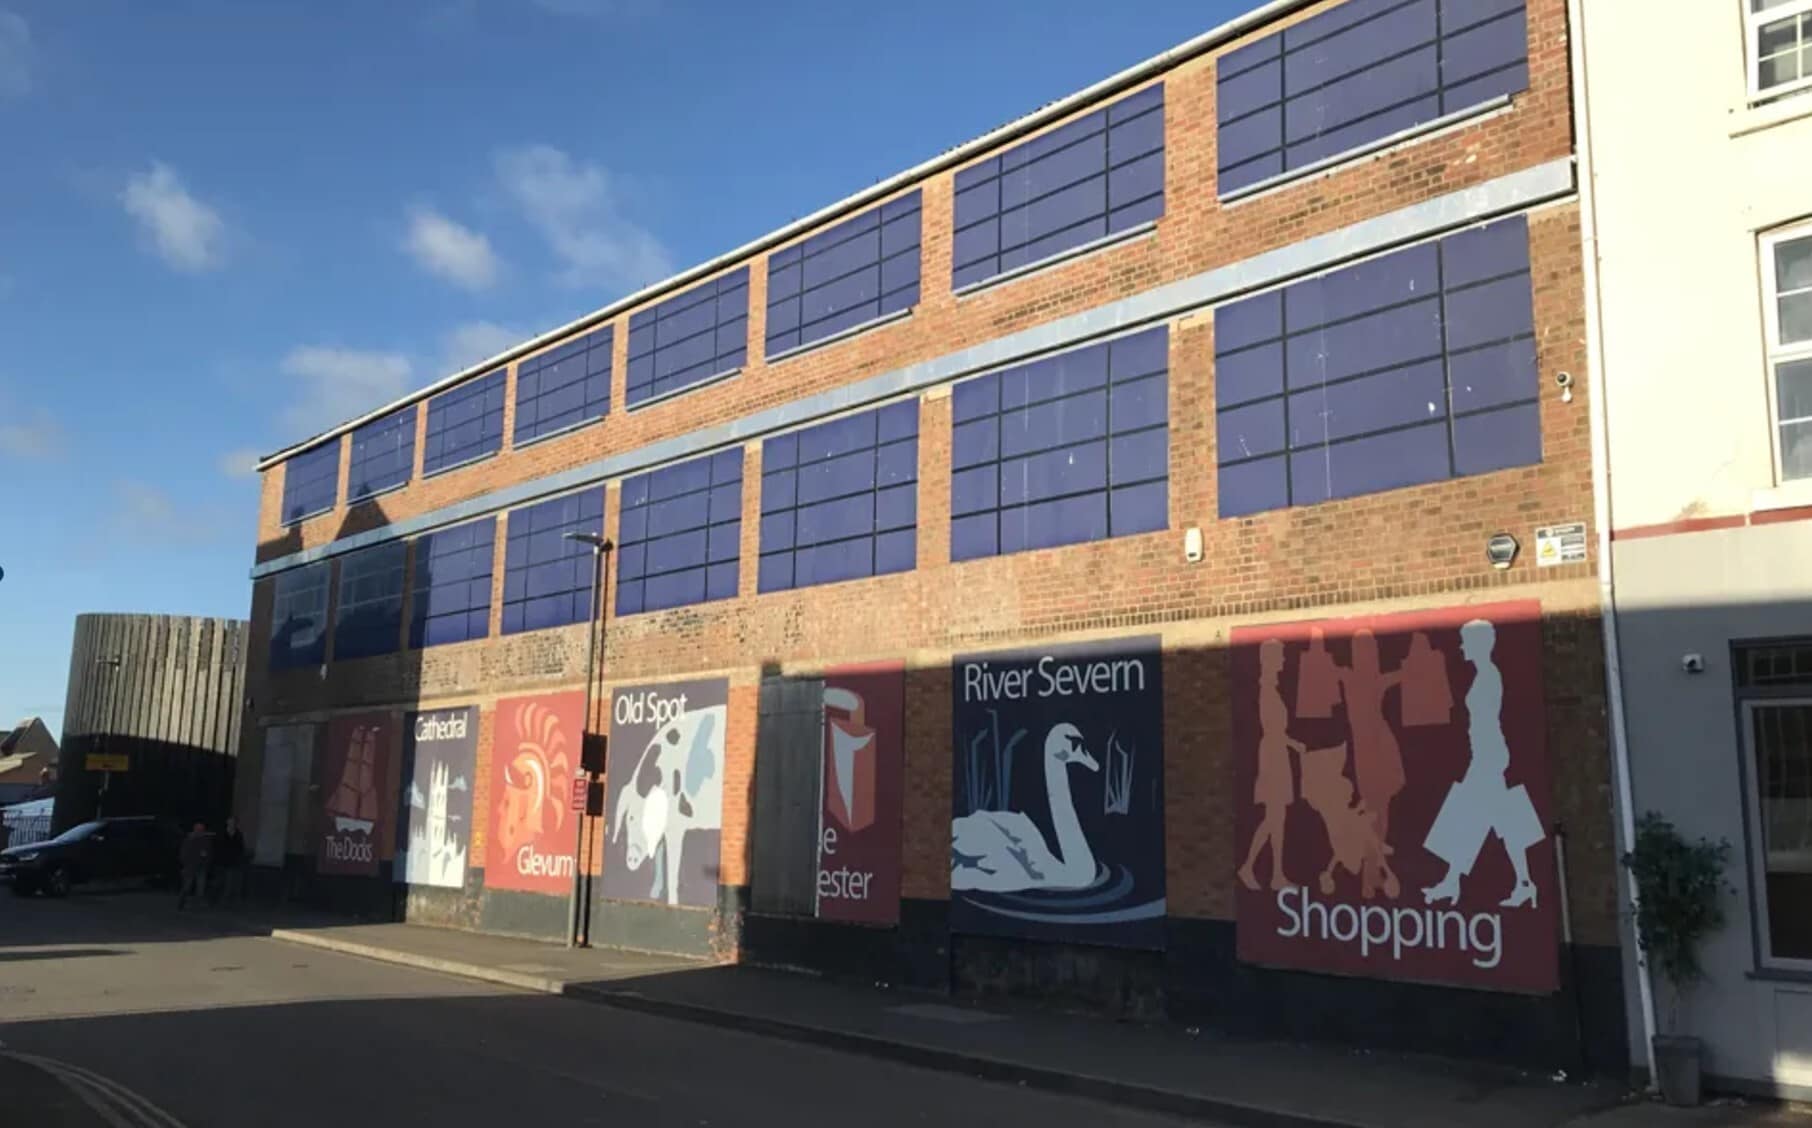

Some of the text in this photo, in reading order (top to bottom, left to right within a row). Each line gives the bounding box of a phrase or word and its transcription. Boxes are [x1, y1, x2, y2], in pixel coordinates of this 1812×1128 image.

[964, 655, 1145, 702] River Severn
[415, 711, 468, 741] Cathedral
[615, 691, 688, 730] Old Spot
[325, 836, 373, 863] The Docks
[517, 844, 573, 877] Glevum
[1276, 886, 1502, 968] Shopping
